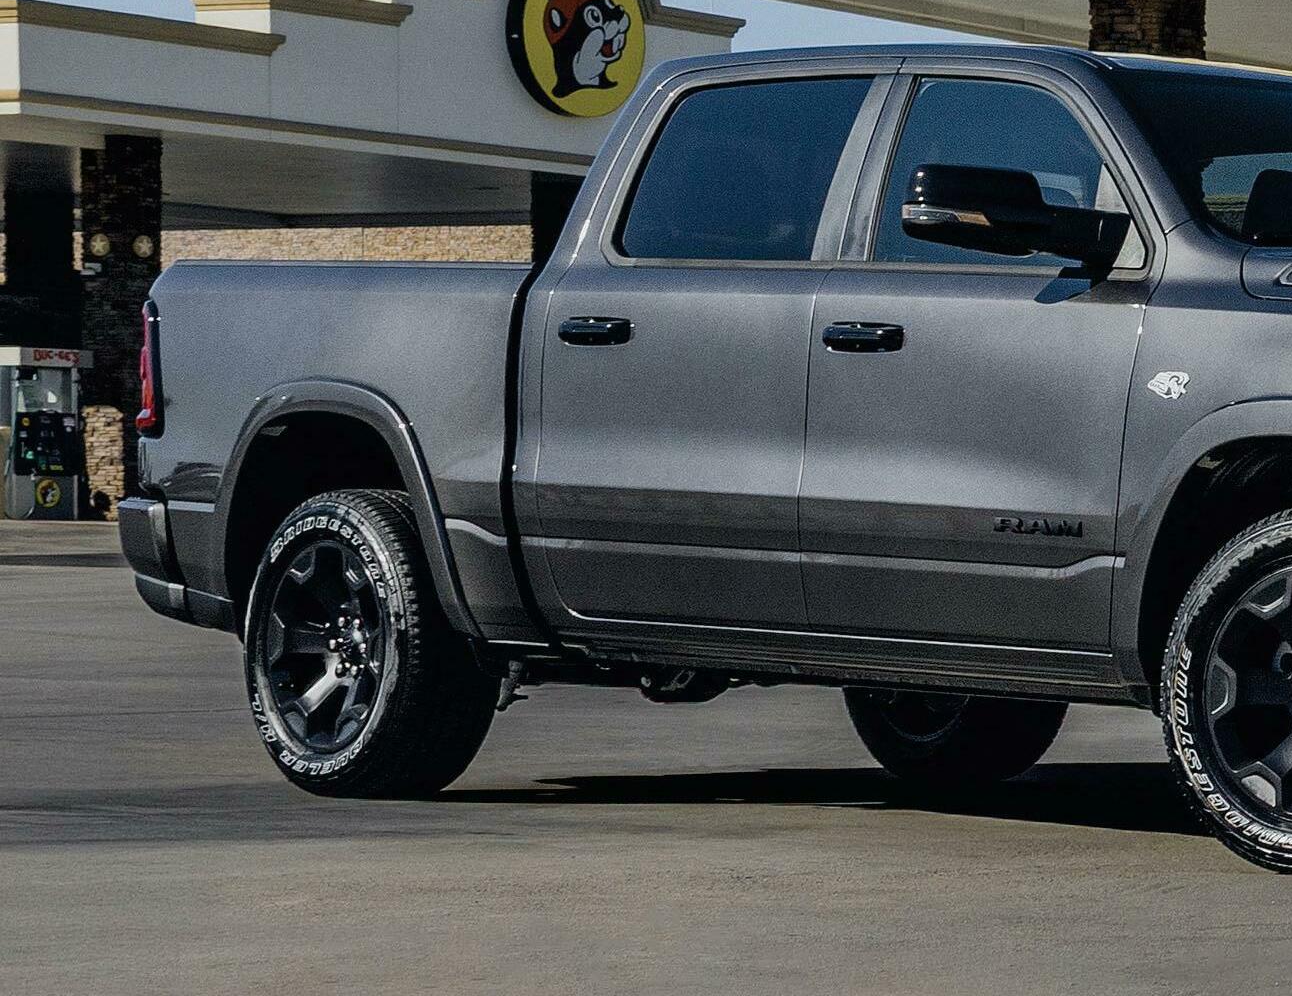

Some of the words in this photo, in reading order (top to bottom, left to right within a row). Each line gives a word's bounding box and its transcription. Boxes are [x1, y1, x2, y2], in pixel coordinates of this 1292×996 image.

[993, 516, 1083, 538] RAM
[270, 515, 387, 599] BRIDGESTONE
[279, 735, 364, 775] DUELER
